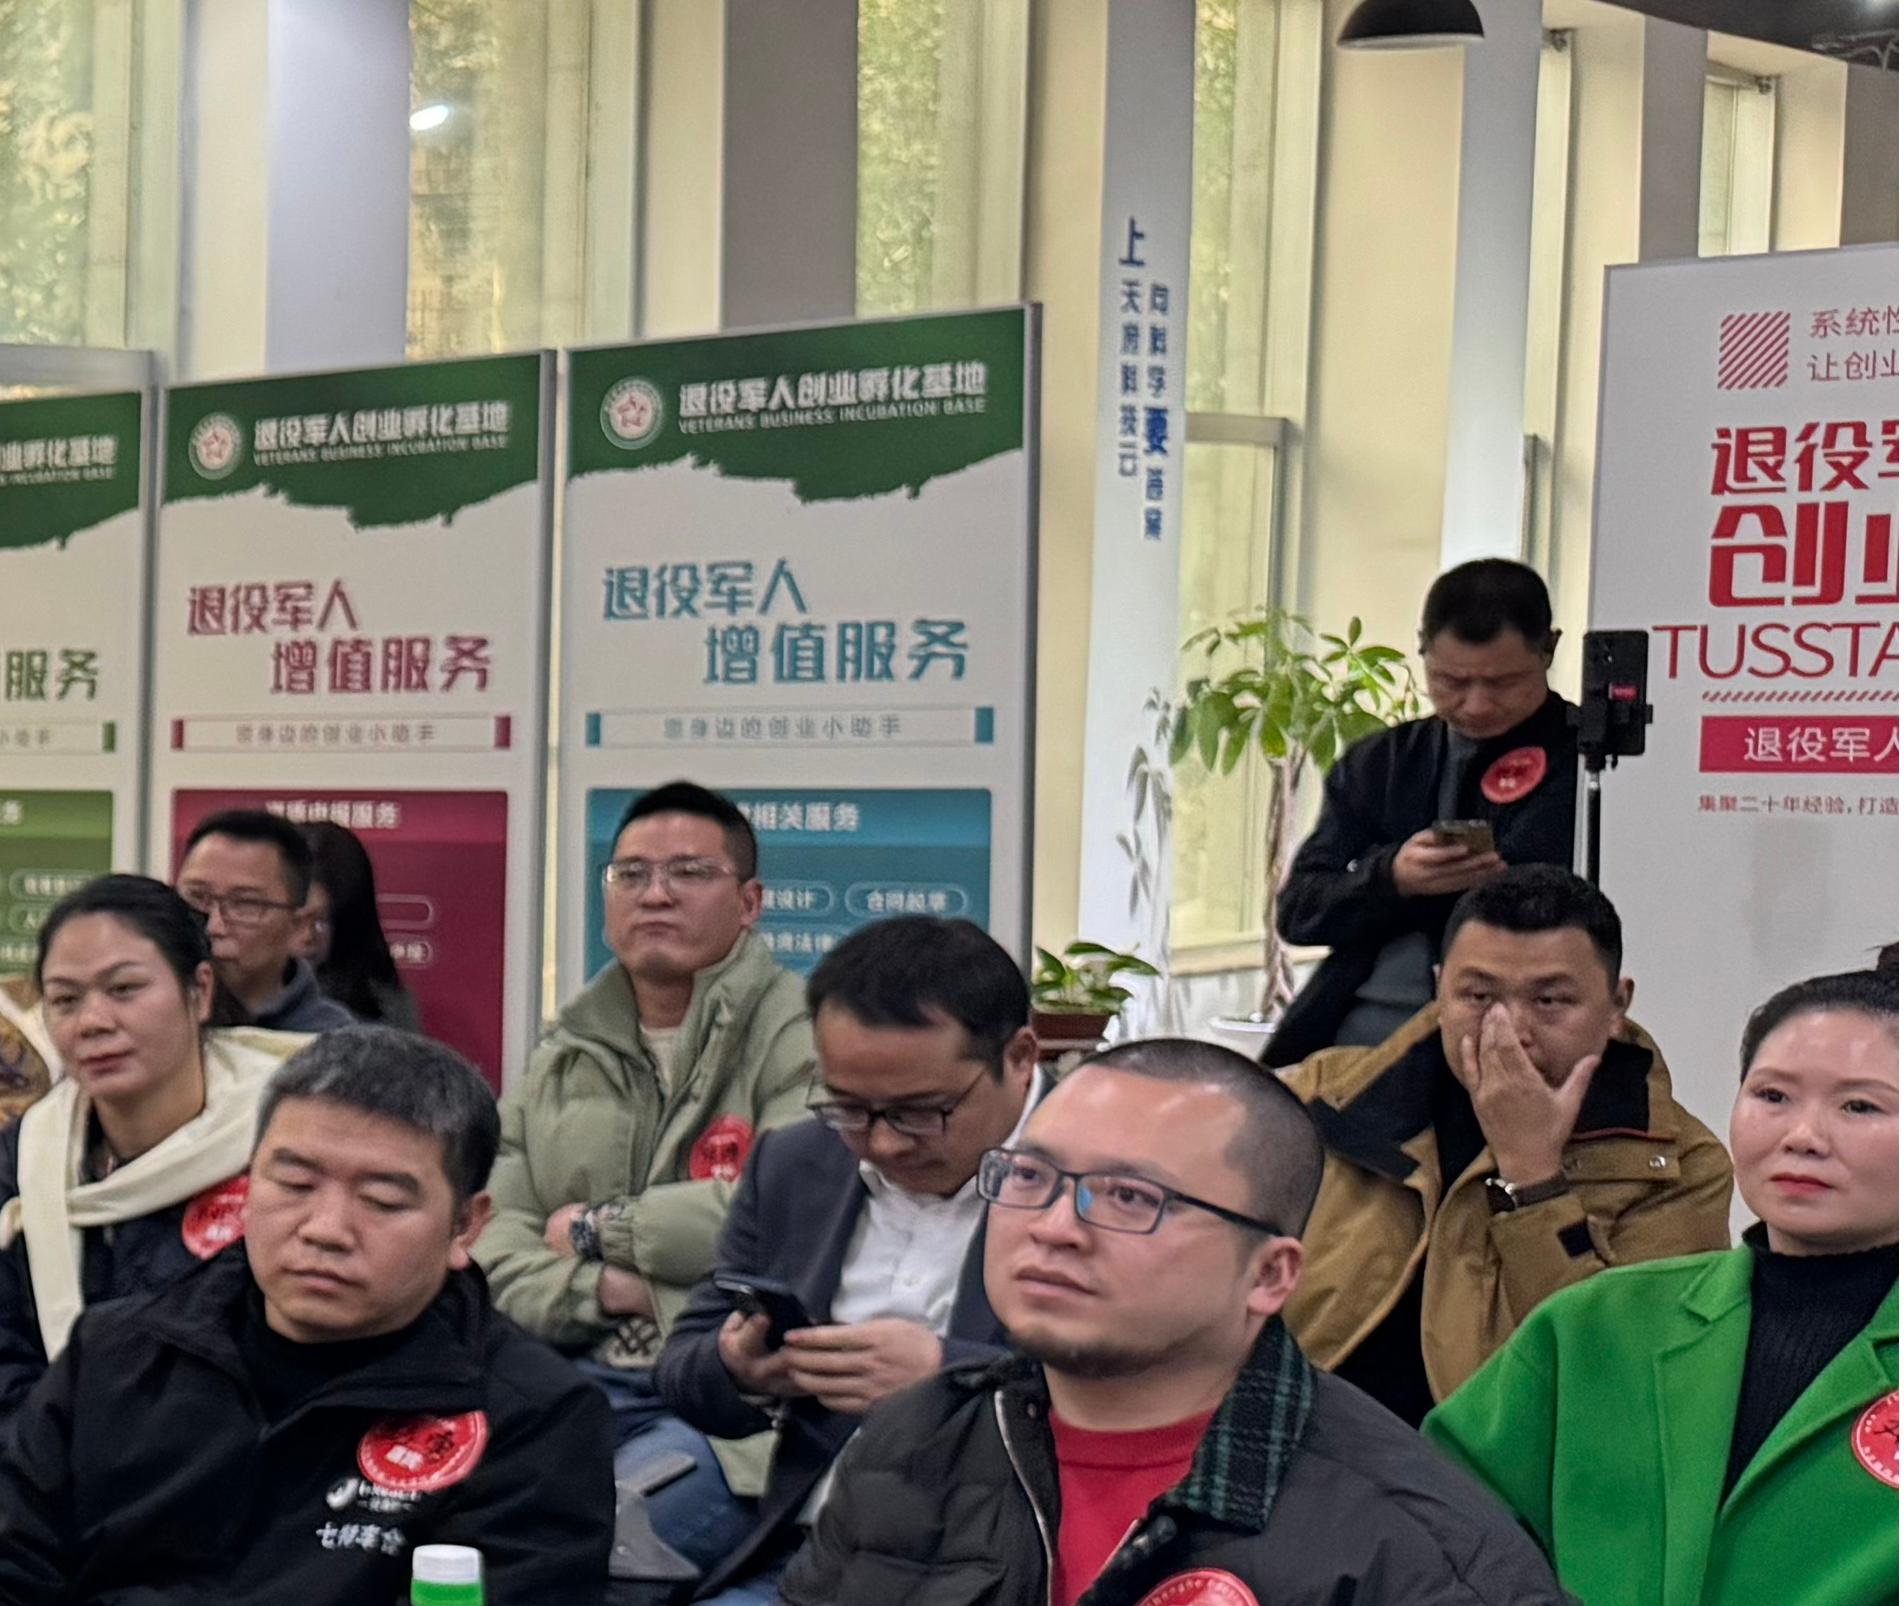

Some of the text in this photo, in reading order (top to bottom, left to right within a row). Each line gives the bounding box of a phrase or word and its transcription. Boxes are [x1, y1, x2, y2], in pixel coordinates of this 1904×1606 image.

[679, 398, 985, 434] VETERANS BUSINESS INCUBATION BASE
[680, 361, 987, 417] 退役军人创业孵化基地
[254, 400, 510, 451] 退役军人创业孵化基地
[1711, 419, 1899, 496] 退役
[186, 578, 359, 636] 退役军人
[603, 558, 807, 620] 退役军人
[271, 636, 494, 695] 增值服务
[703, 618, 970, 686] 增值服务
[1745, 727, 1899, 762] 退役军人
